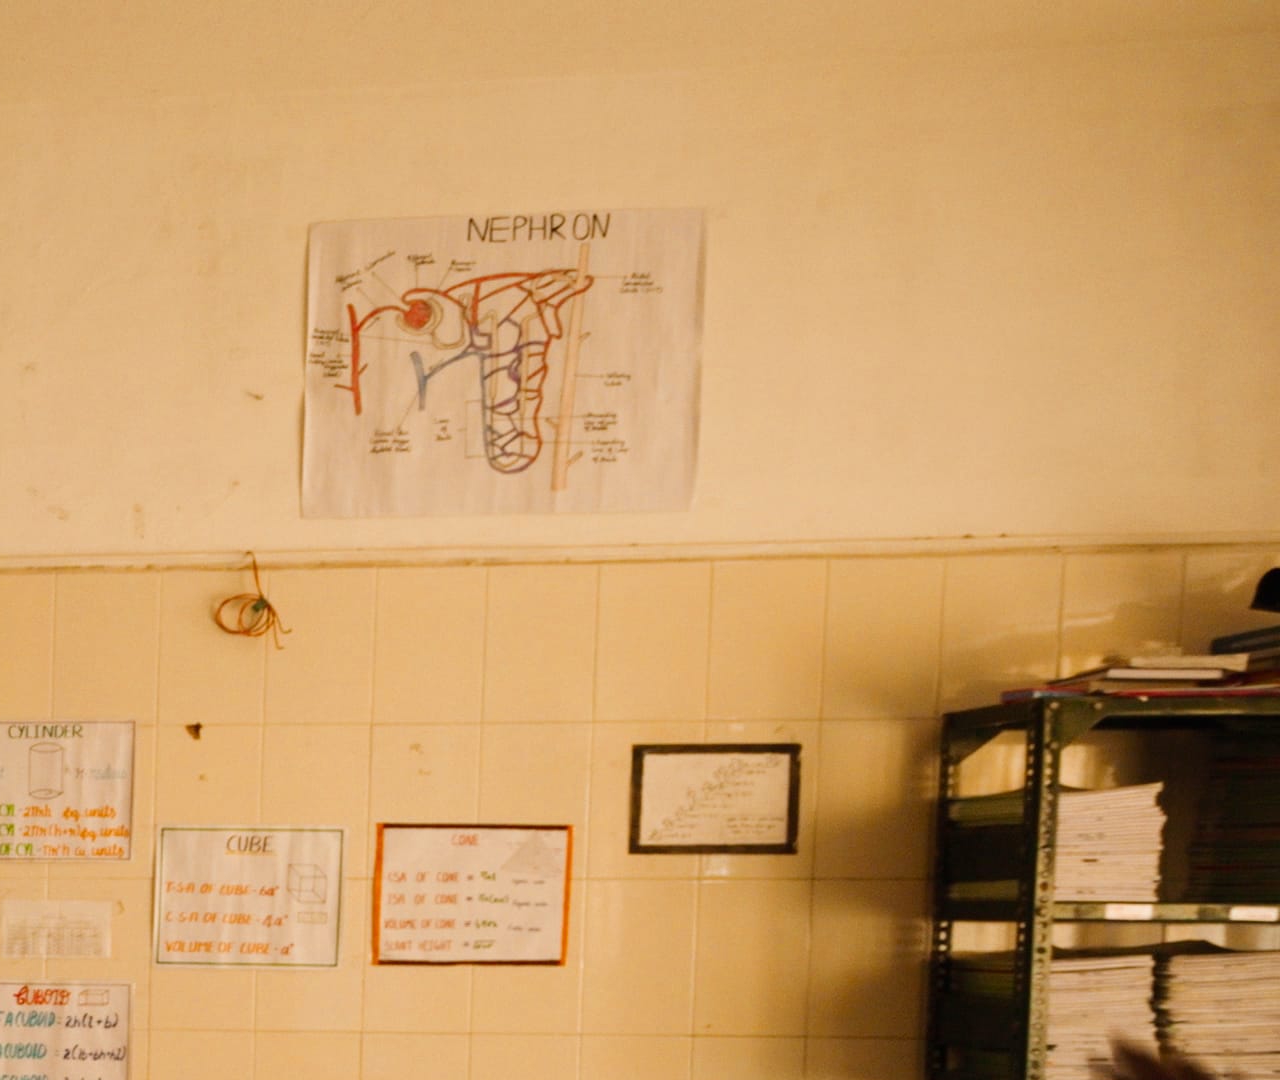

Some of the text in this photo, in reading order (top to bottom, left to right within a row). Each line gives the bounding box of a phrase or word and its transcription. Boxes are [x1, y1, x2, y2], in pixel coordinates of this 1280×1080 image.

[467, 213, 611, 243] NEPHRON
[8, 724, 84, 739] CYLINDER
[226, 835, 273, 853] CUBE
[450, 833, 480, 847] CONE
